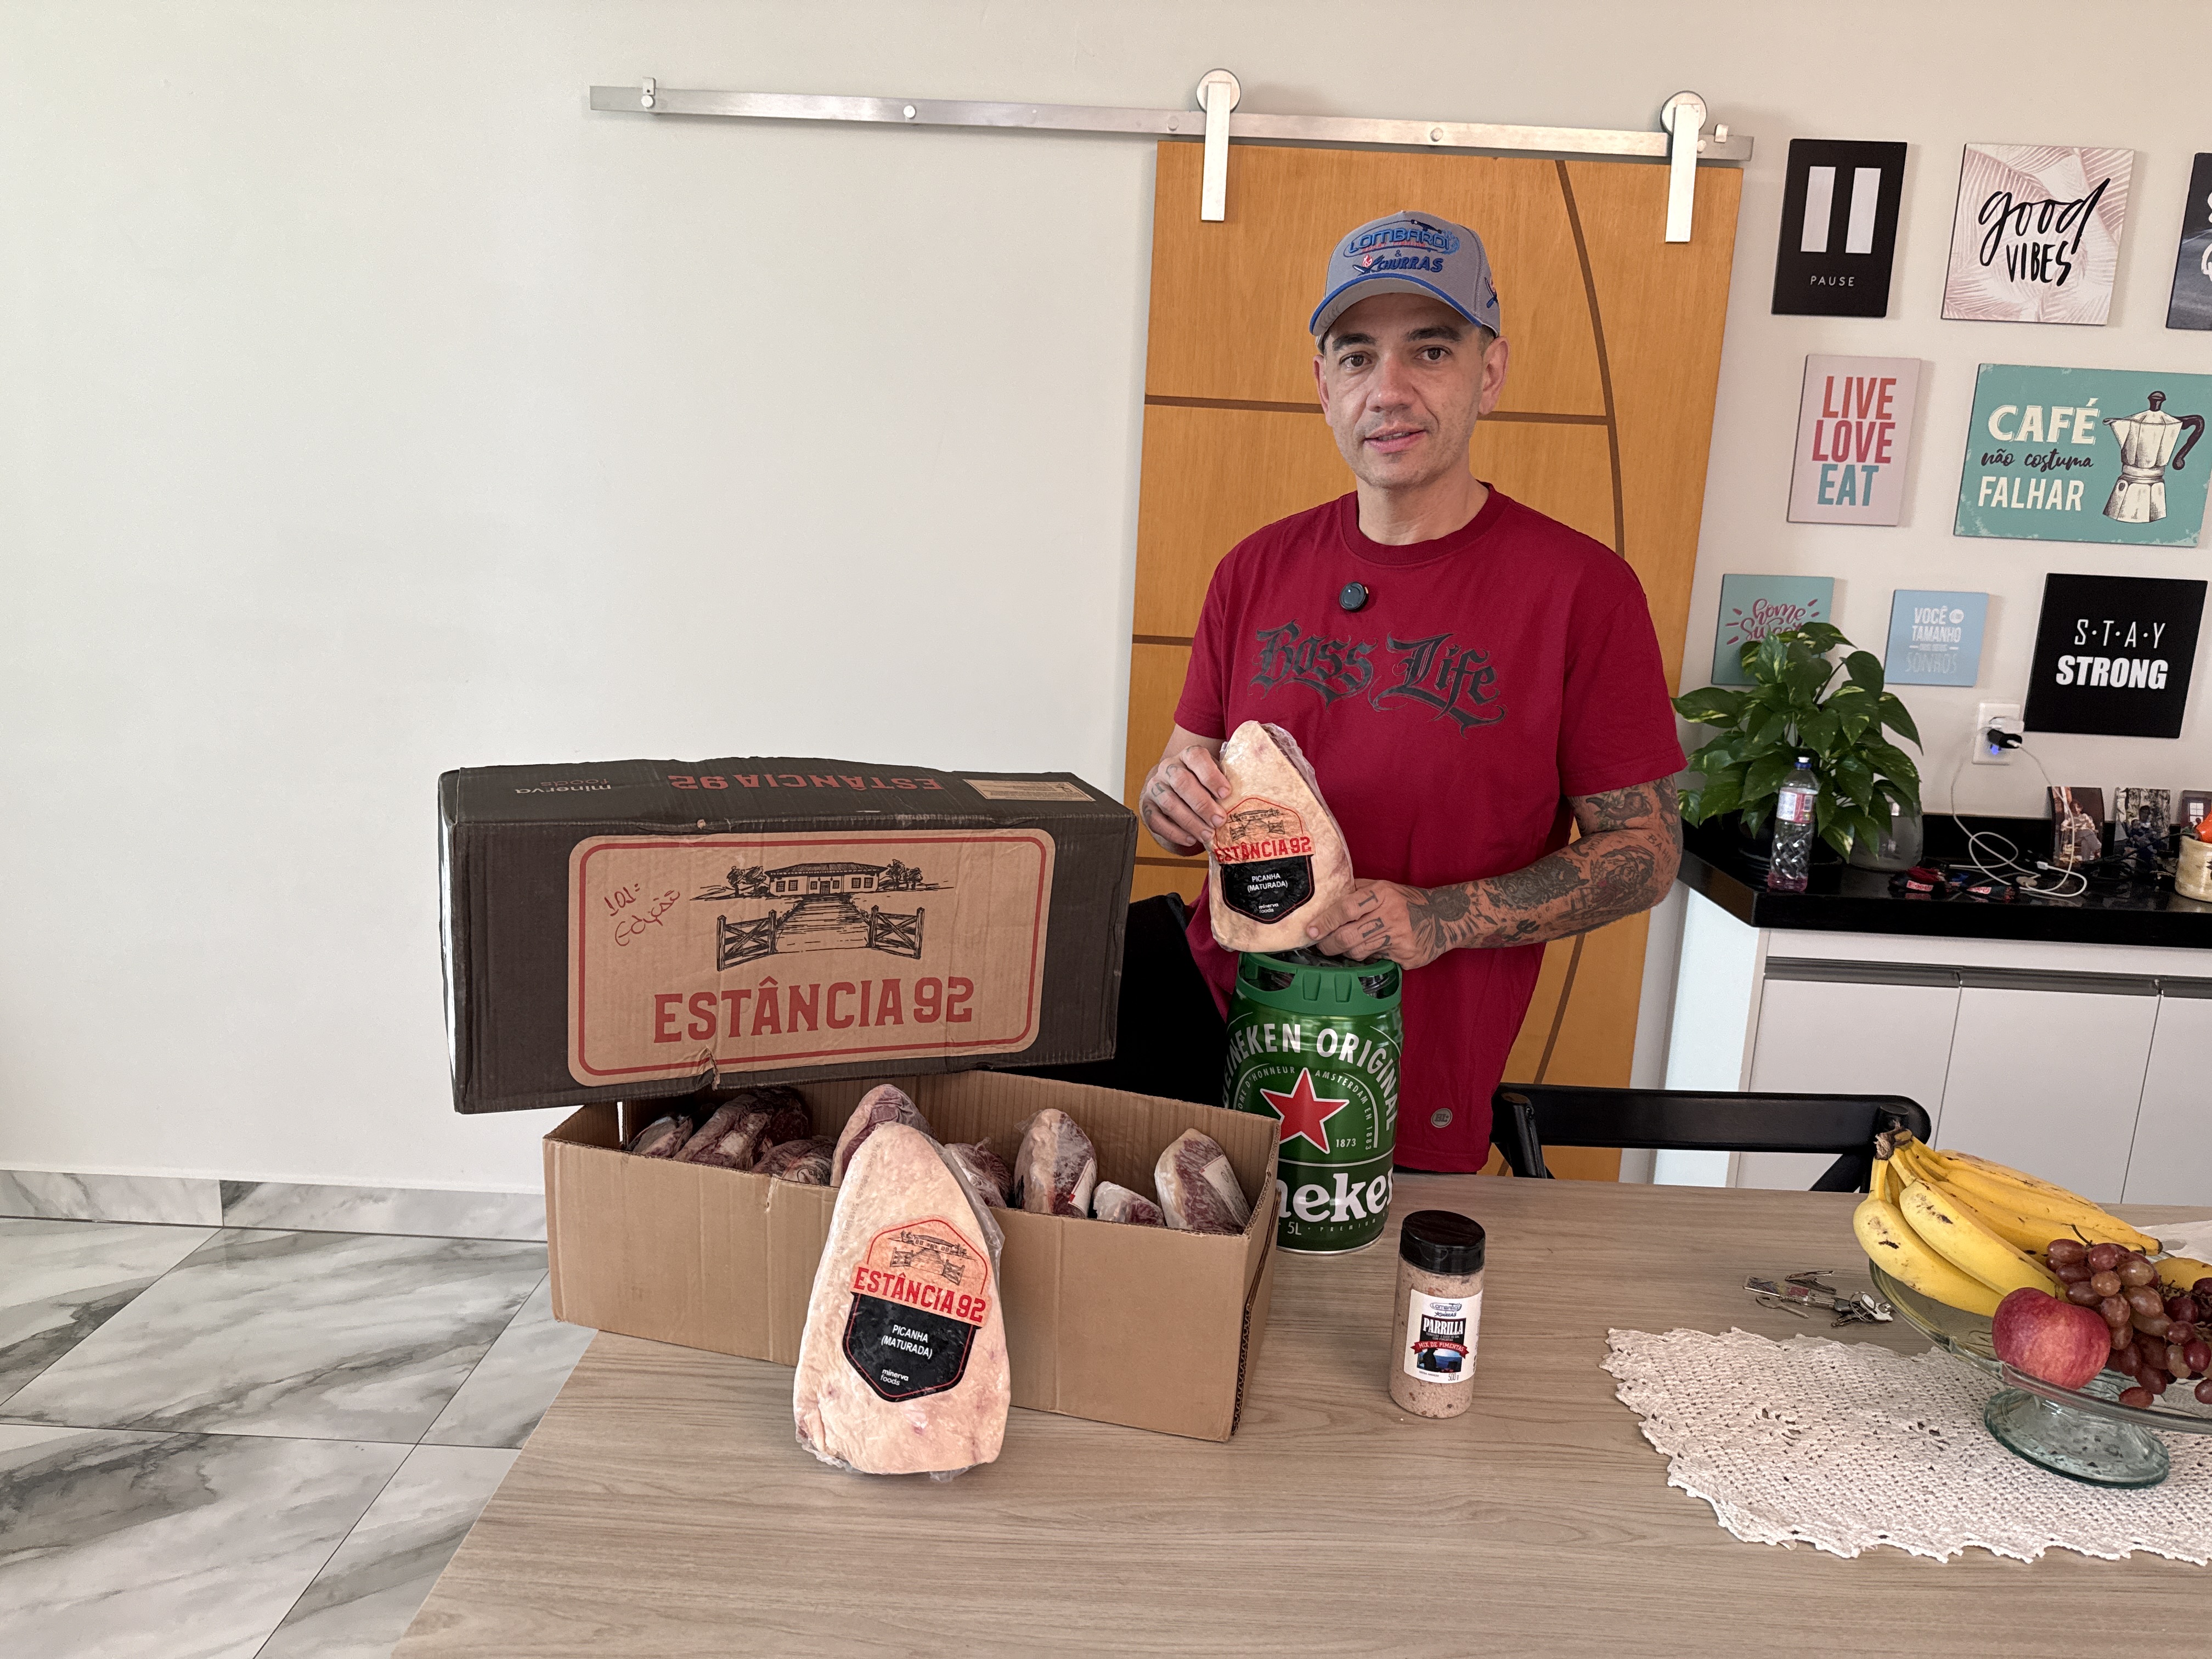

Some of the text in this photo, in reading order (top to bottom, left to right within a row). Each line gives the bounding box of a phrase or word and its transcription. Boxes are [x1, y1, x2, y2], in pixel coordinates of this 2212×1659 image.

[1978, 178, 2111, 266] good
[1349, 228, 1449, 253] LOMBARDI
[2006, 240, 2073, 286] VIBES
[1810, 275, 1855, 287] PAUSE
[1822, 376, 1897, 420] LIVE
[1987, 398, 2102, 445] CAFÉ
[1812, 420, 1895, 464] LOVE
[1980, 449, 2094, 473] não costuma
[1817, 464, 1879, 507] EAT
[1977, 476, 2085, 512] FALHAR
[1914, 605, 1948, 625] VOCÊ
[1912, 625, 1962, 643] TAMANHO
[2056, 654, 2169, 690] STRONG
[1369, 631, 1508, 740] Life
[515, 785, 611, 794] minerva
[540, 778, 609, 787] foods
[1247, 880, 1288, 893] (MATURADA)
[1251, 873, 1280, 882] PICANHA
[1245, 1066, 1295, 1088] D'HONNEUR
[1315, 1070, 1367, 1105] AMSTERDAM
[1317, 1029, 1397, 1131] ORIGINAL
[1364, 1107, 1373, 1120] EN
[1336, 1138, 1356, 1148] 1873
[1364, 1125, 1373, 1150] 1883
[1287, 1218, 1376, 1235] 5L PREMIUM
[892, 1324, 928, 1344] PICANHA
[1423, 1318, 1463, 1334] PARRILLA
[881, 1336, 932, 1359] (MATURADA)
[1439, 1342, 1465, 1351] PIMENTAS
[880, 1374, 900, 1386] foods
[882, 1369, 909, 1381] minerva
